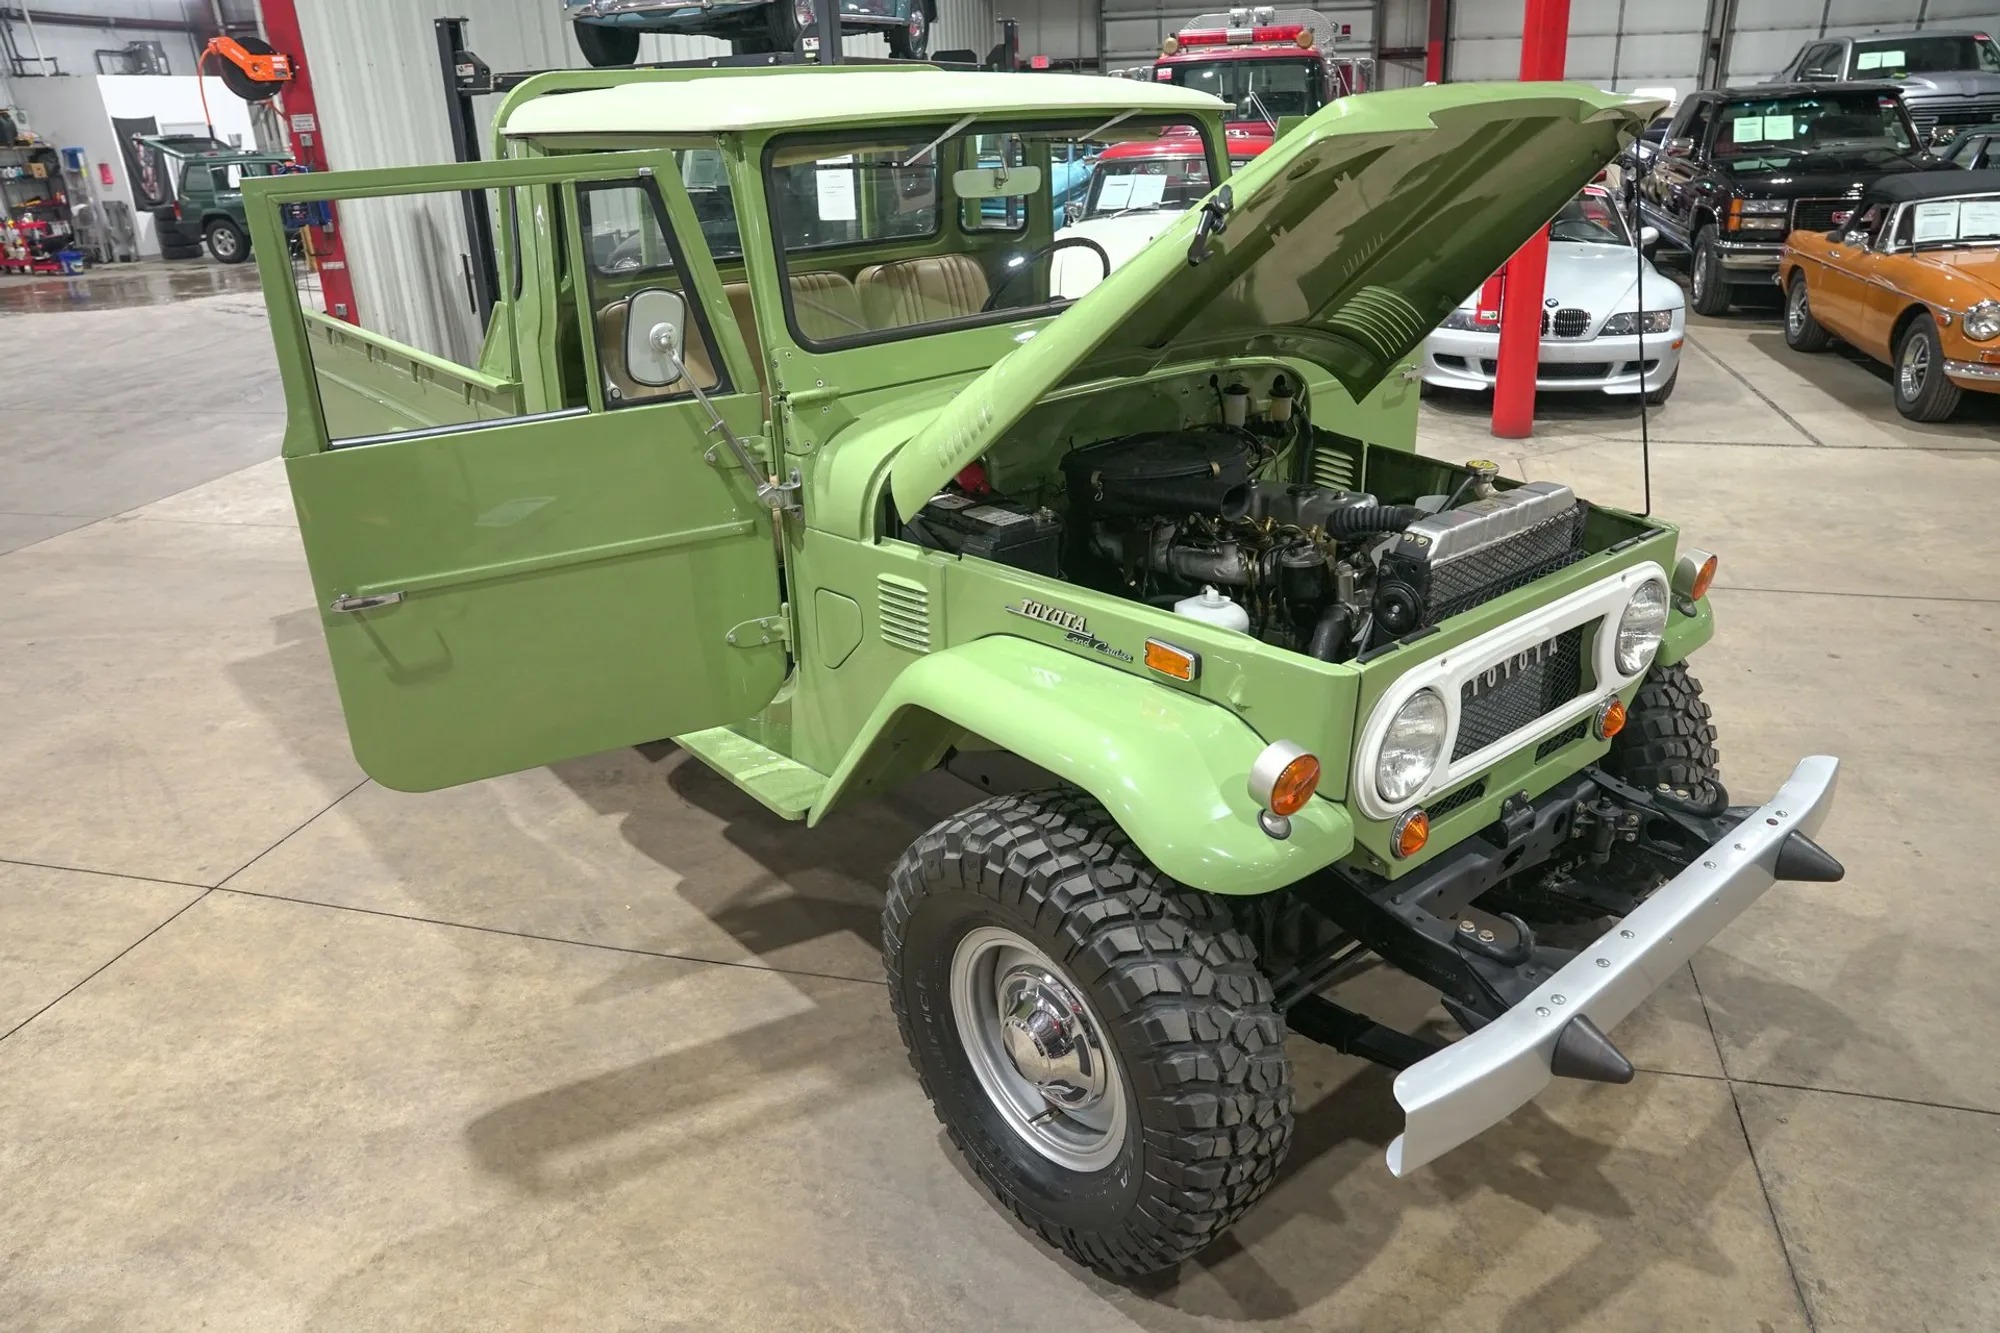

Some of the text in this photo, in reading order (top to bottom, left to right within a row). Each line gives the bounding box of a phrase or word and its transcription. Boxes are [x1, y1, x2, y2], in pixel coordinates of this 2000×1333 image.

[1021, 599, 1087, 632] TOYOTA
[1063, 631, 1134, 662] Land Cruiser
[1471, 636, 1558, 697] TOYOTA
